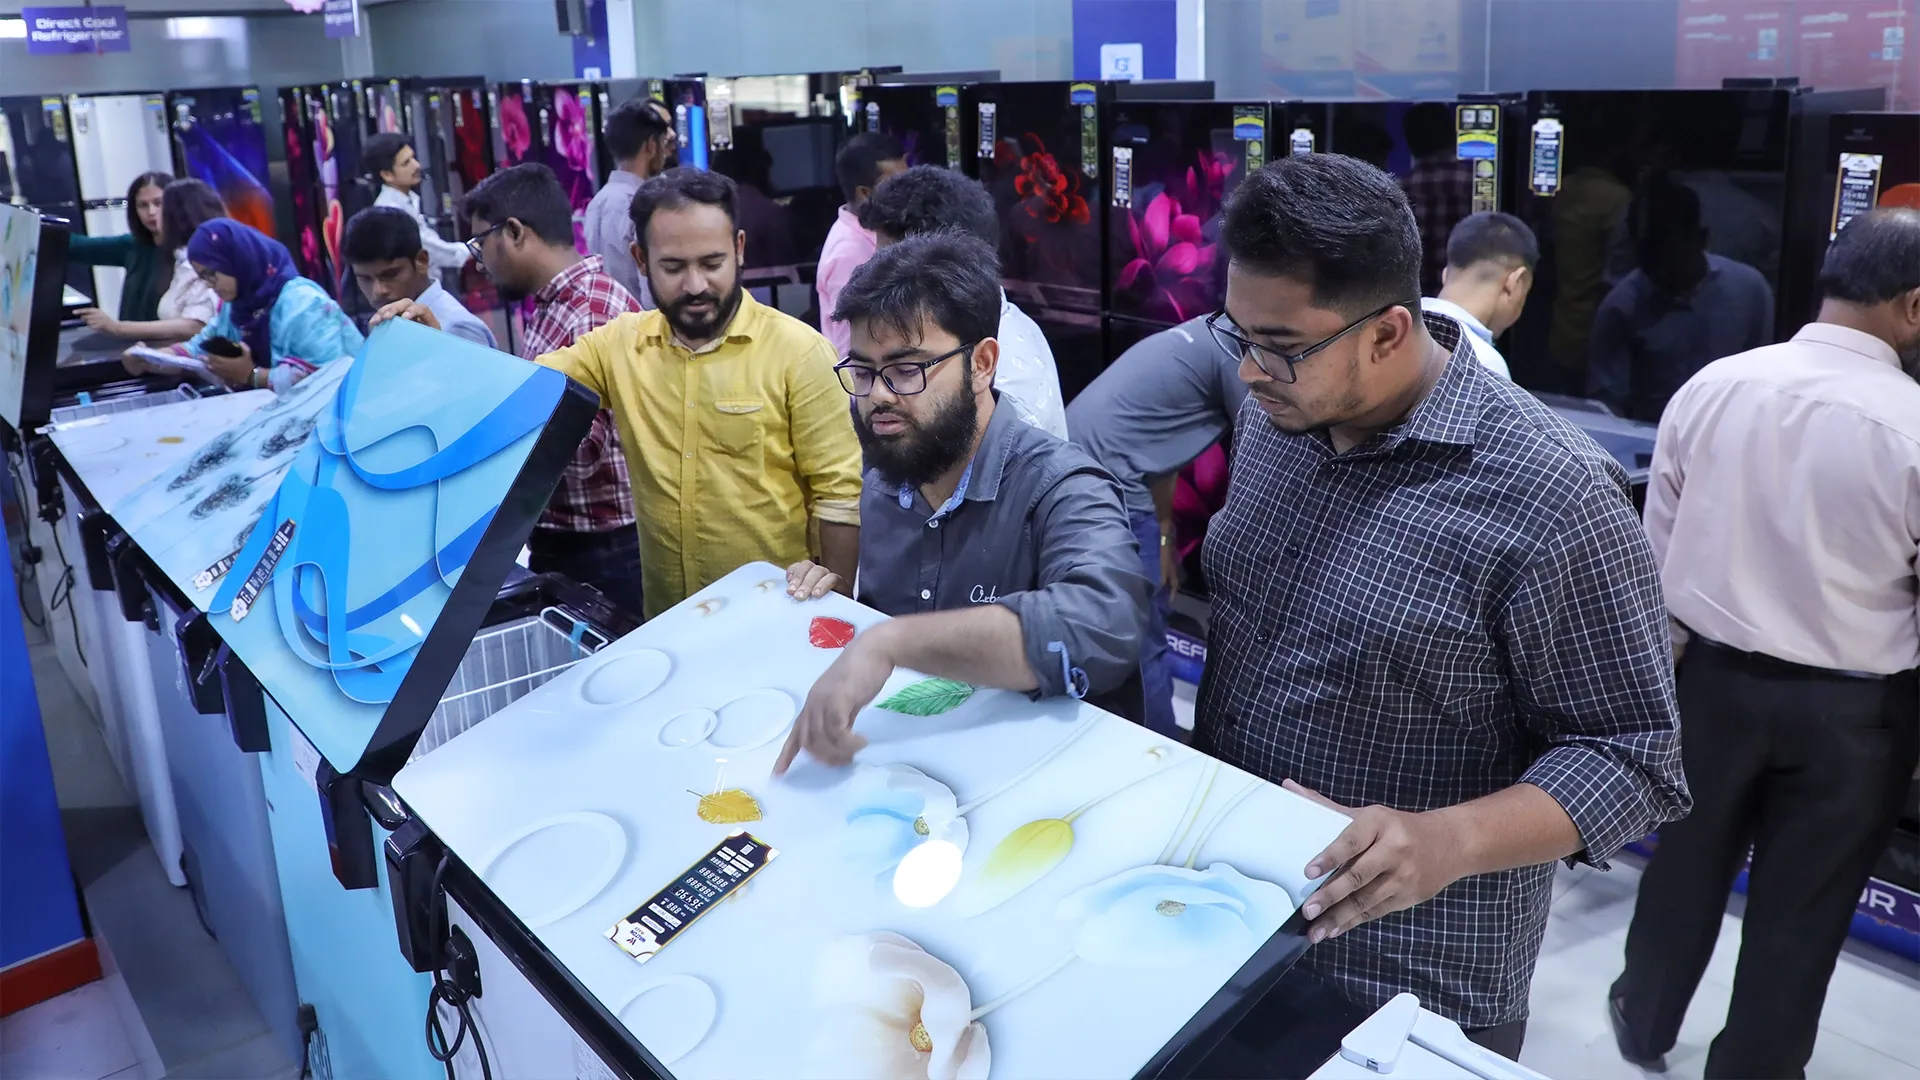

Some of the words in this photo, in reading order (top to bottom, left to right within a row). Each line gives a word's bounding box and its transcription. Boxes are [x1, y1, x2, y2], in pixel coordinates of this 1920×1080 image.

[35, 17, 80, 29] Direct
[83, 17, 116, 29] Cool
[31, 29, 124, 43] Refrigerator
[675, 888, 704, 909] 36490
[629, 929, 646, 943] WALTON
